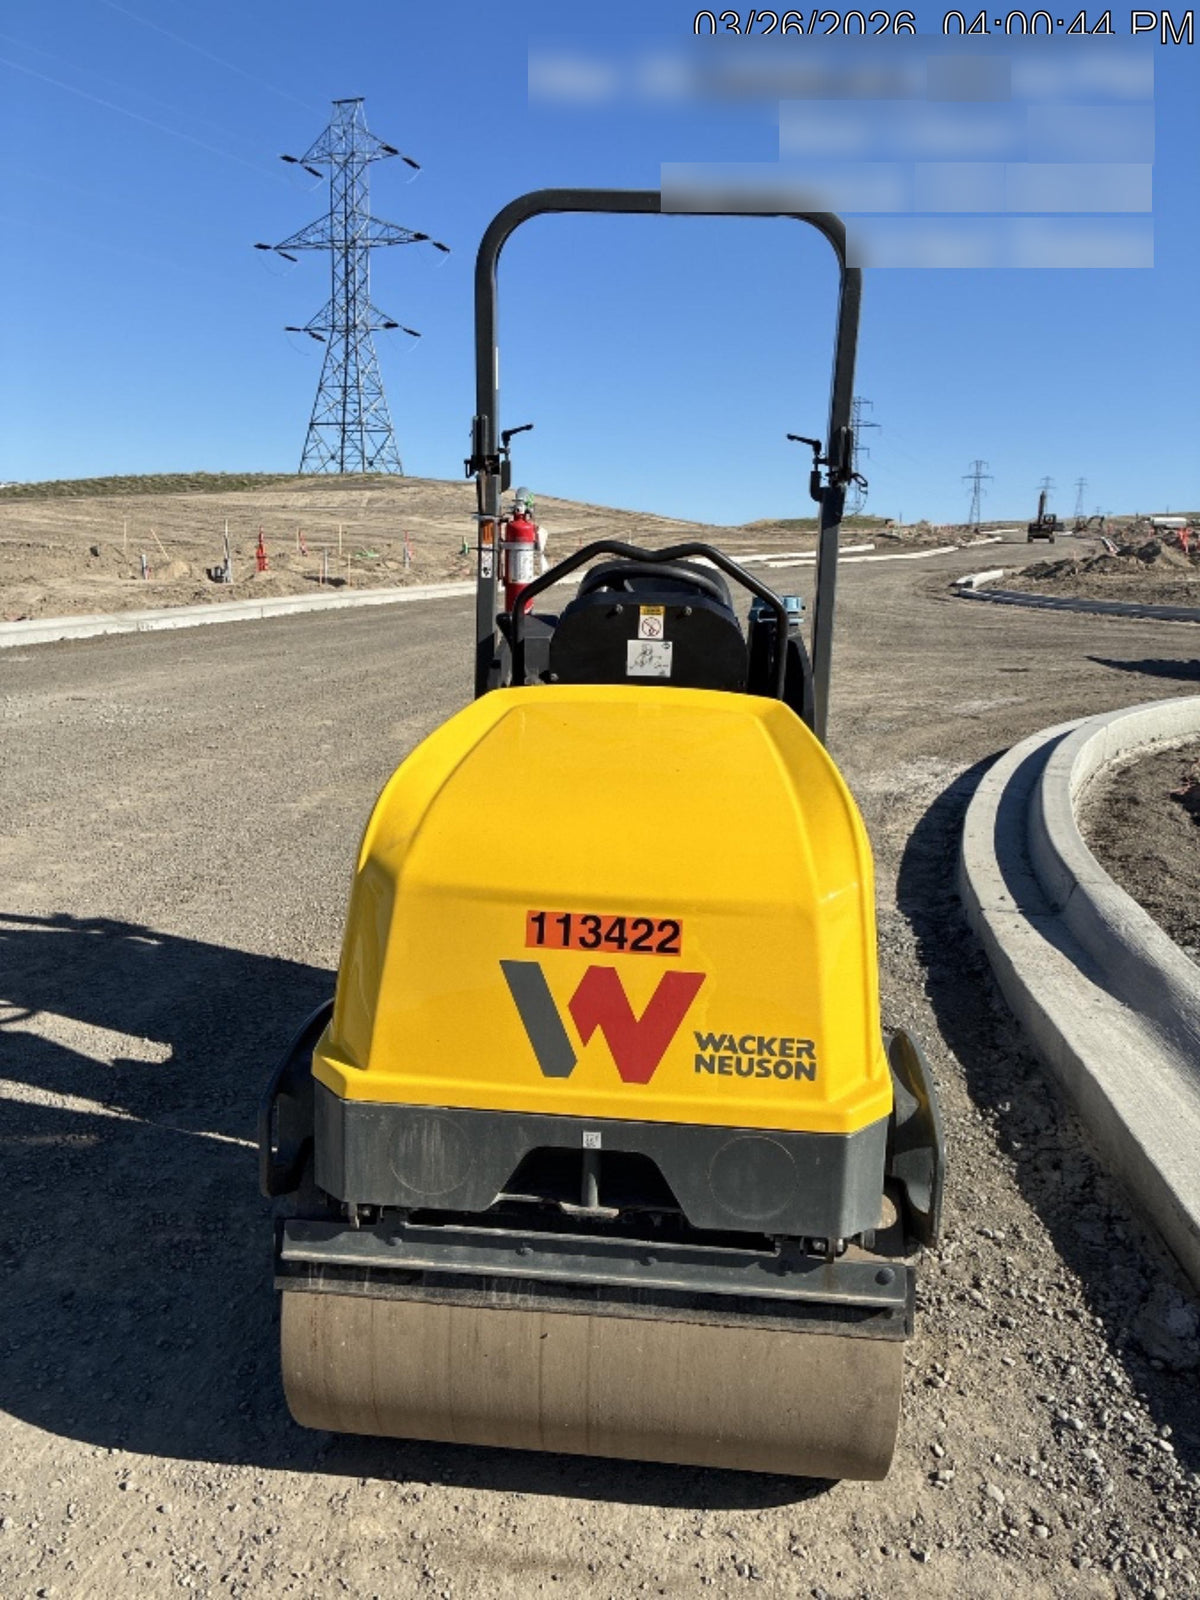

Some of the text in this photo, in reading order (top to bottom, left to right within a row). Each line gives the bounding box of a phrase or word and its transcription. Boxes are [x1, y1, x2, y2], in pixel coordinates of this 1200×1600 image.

[530, 910, 681, 954] 113422
[693, 1031, 816, 1060] WACKER
[694, 1054, 817, 1082] NEUSON
